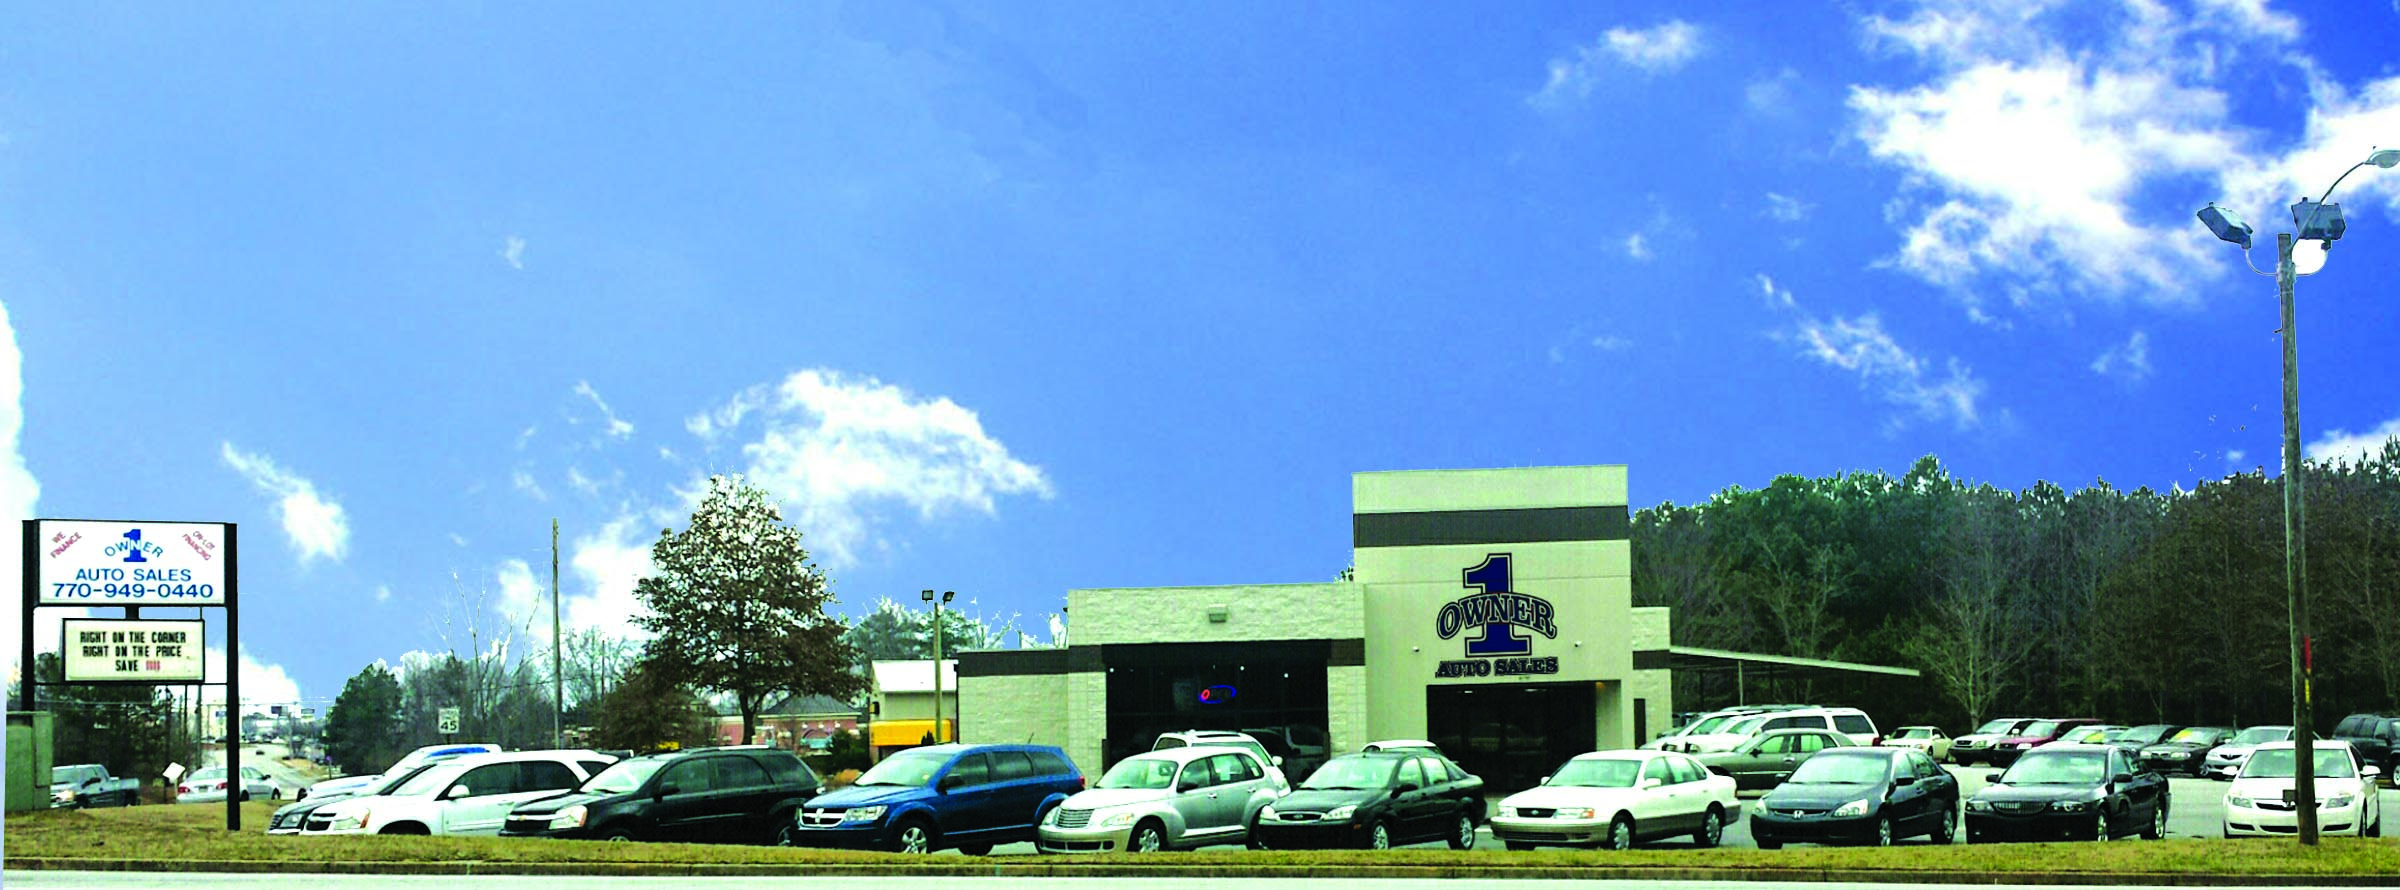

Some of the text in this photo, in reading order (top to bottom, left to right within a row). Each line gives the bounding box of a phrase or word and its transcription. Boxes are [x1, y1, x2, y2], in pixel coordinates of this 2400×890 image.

[50, 532, 82, 559] FINANCE
[52, 531, 66, 543] WE
[123, 529, 147, 562] 1
[104, 539, 163, 558] OWNER
[182, 533, 212, 561] FINANCING
[75, 568, 192, 582] AUTO SALES
[52, 583, 214, 598] 770-949-0440
[1463, 553, 1532, 658] 1
[1437, 592, 1557, 640] OWNER
[80, 631, 187, 643] RIGHT ON THE CORNER
[82, 645, 182, 657] RIGHT ON THE PRICE
[115, 659, 138, 672] SAVE
[1435, 656, 1559, 678] AUTO SALES
[440, 720, 457, 731] 45
